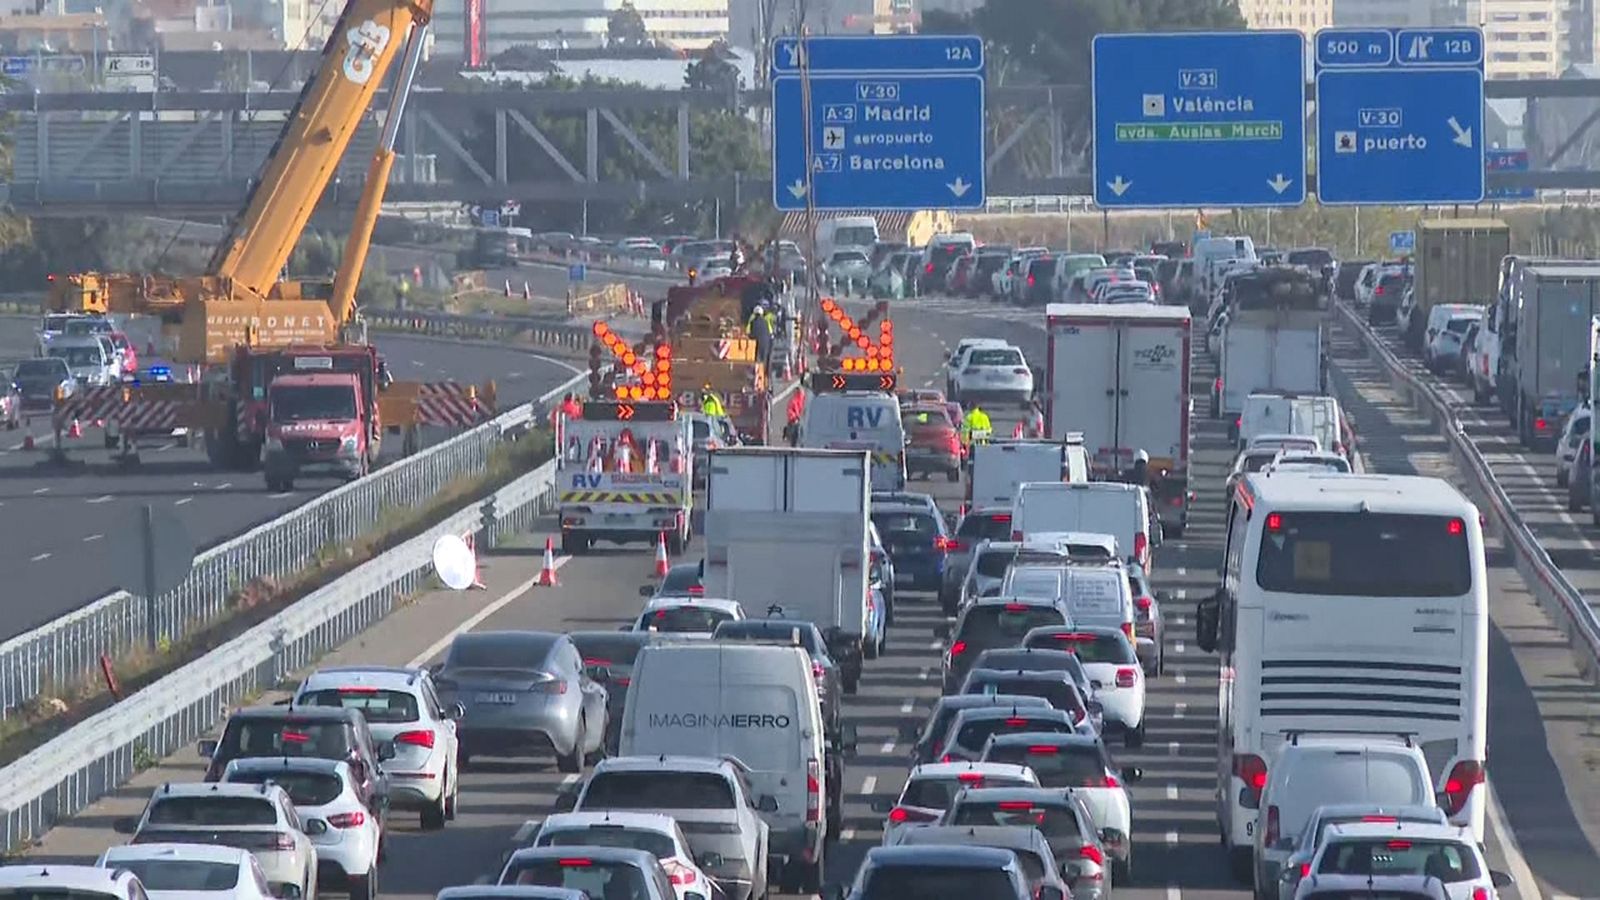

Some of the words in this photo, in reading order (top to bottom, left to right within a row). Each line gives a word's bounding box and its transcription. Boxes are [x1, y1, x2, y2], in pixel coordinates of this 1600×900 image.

[944, 47, 972, 60] 12A
[1327, 42, 1359, 55] 500
[1368, 45, 1382, 54] m
[1443, 41, 1472, 54] 12B
[1182, 73, 1215, 86] V-31
[860, 86, 897, 98] V-30
[826, 107, 854, 120] A-3
[865, 105, 931, 121] Madrid
[1361, 111, 1399, 124] V-30
[1118, 127, 1159, 139] avda.
[1232, 124, 1280, 138] March
[853, 132, 933, 146] aeropuerto
[1364, 133, 1428, 153] puerto
[813, 157, 839, 170] A-7
[850, 154, 945, 170] Barcelona
[251, 316, 325, 328] BONET
[849, 407, 882, 427] RV
[572, 474, 602, 488] RV
[649, 713, 791, 730] IMAGINAIERRO
